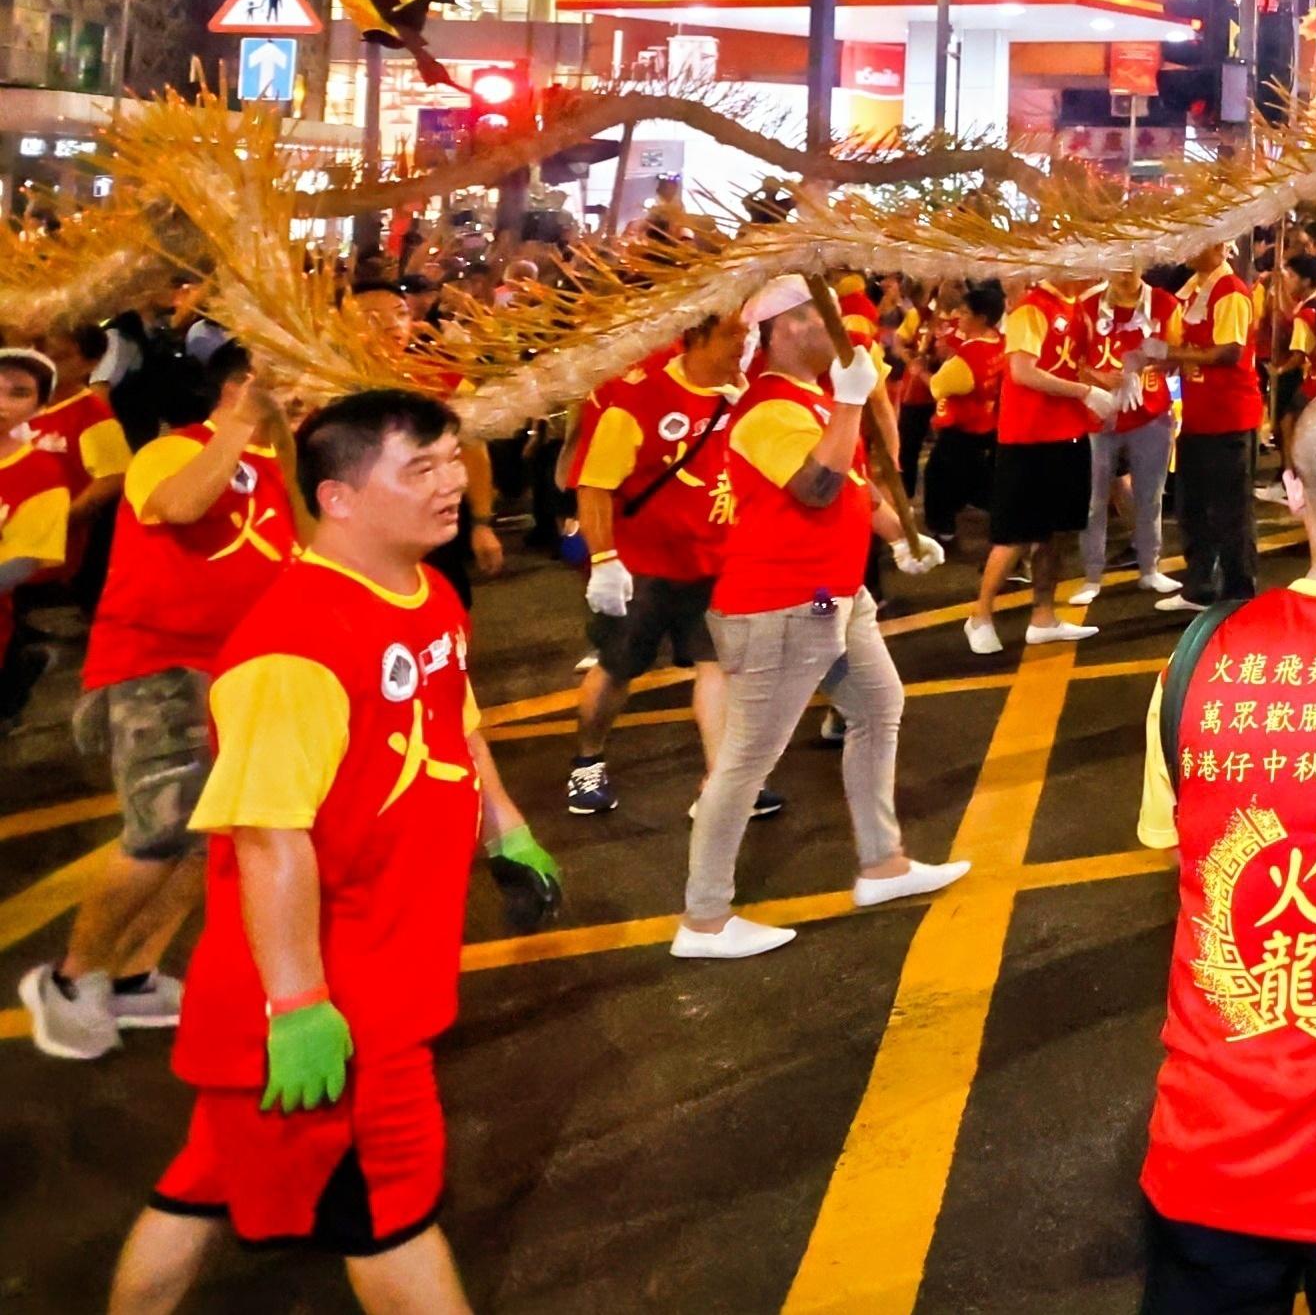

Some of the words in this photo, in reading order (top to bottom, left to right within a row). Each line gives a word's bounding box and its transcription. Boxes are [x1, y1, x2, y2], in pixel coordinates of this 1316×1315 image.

[1048, 336, 1077, 372] 火
[1095, 337, 1123, 369] 火
[206, 497, 283, 562] 火
[377, 699, 470, 817] 火
